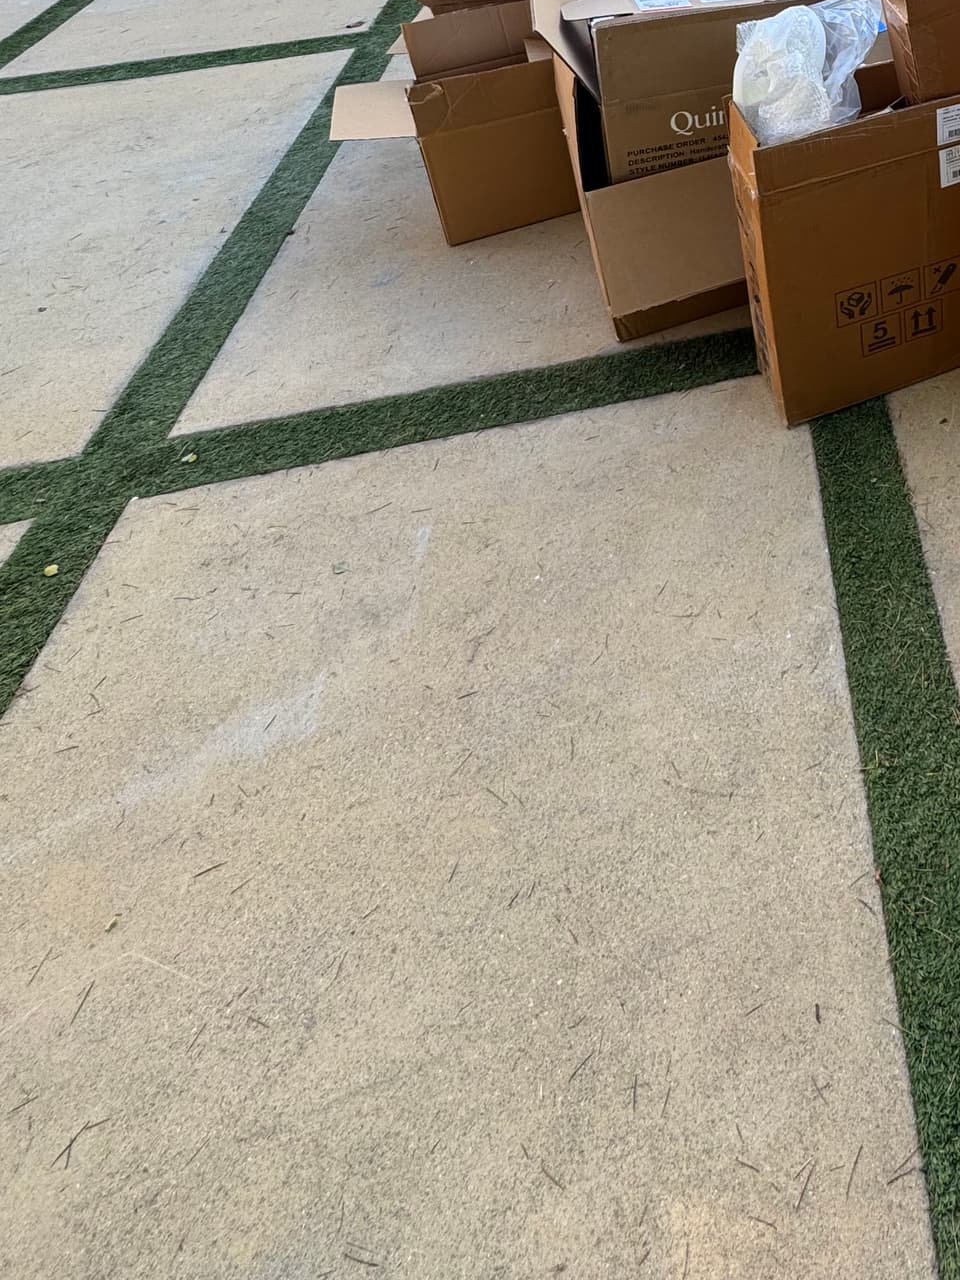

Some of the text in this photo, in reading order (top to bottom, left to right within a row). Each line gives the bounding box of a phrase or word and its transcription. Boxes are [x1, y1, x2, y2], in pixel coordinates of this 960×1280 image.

[627, 143, 674, 157] PURCHASE
[628, 163, 657, 176] STYLE
[873, 321, 888, 339] 5
